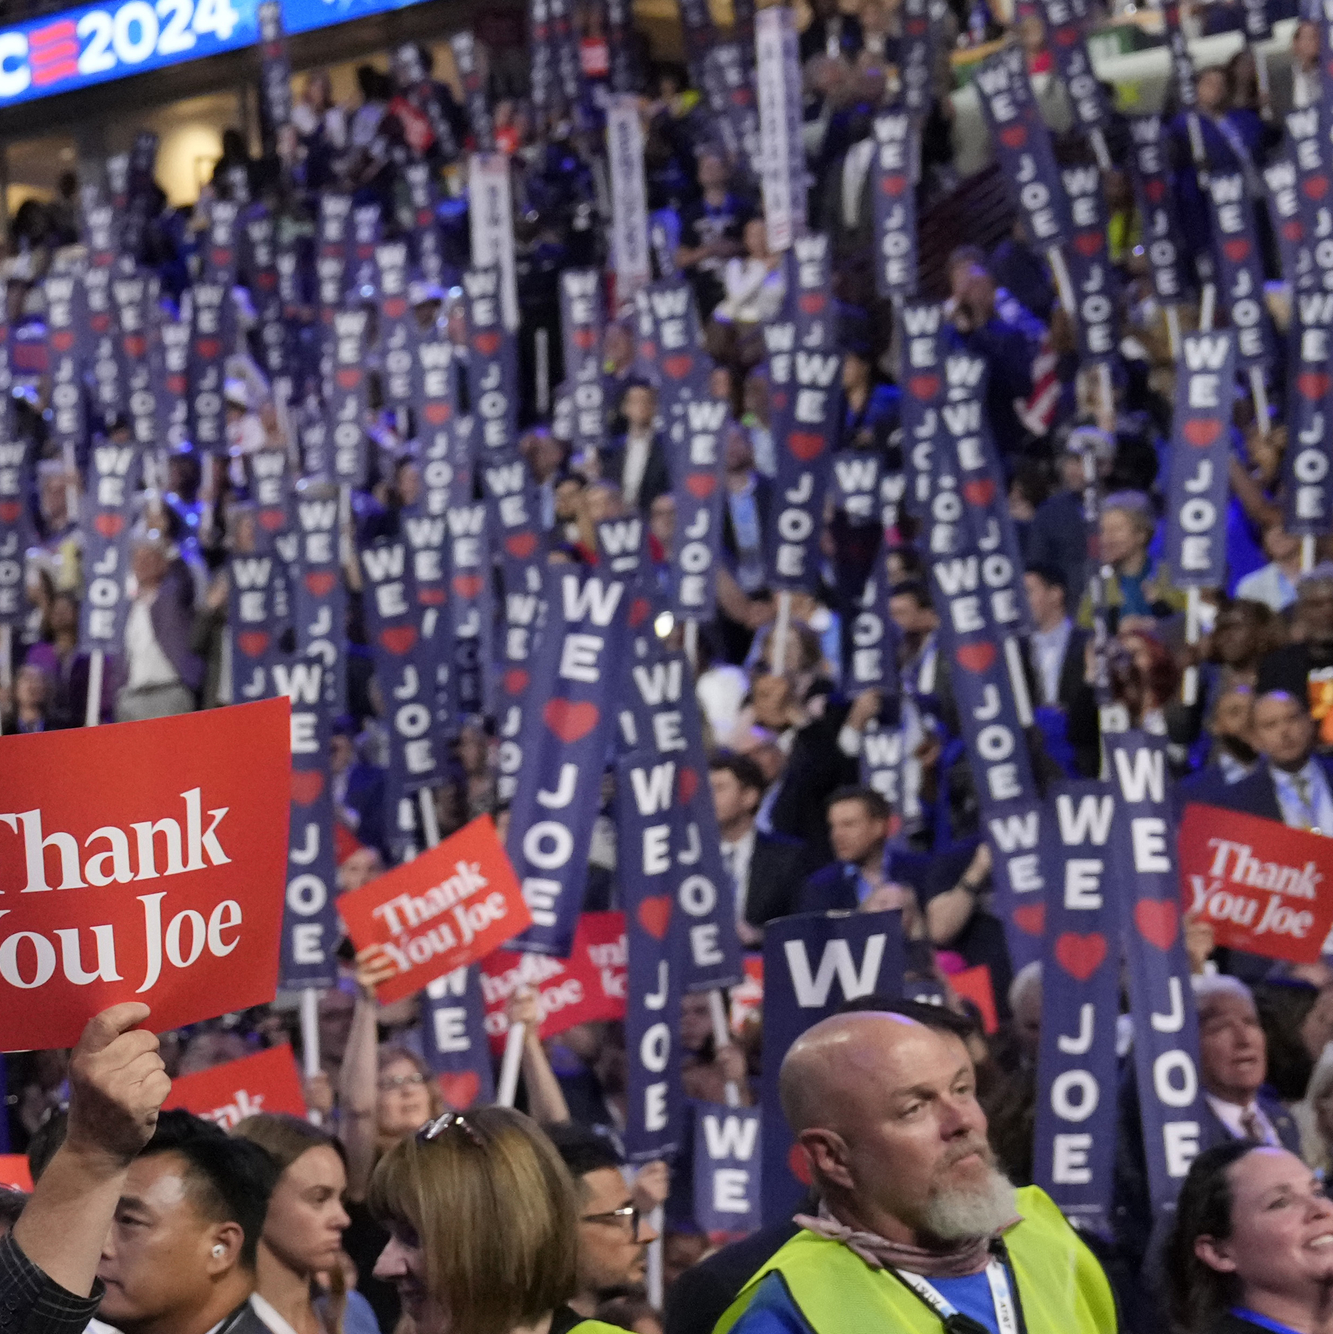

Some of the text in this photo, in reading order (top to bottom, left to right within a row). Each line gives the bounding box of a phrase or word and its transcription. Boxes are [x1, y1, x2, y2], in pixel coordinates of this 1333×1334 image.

[76, 0, 237, 73] 2024
[978, 68, 1018, 123] WE
[1285, 108, 1322, 170] WE
[874, 115, 910, 288] WE JOE
[1264, 162, 1298, 217] WE
[563, 271, 598, 323] WE
[1062, 167, 1114, 354] WE JOE
[1210, 175, 1265, 358] WE JOE
[333, 311, 368, 362] WE
[463, 271, 509, 446] WE JOE
[650, 287, 688, 349] WE
[903, 305, 940, 367] WE
[420, 341, 450, 396] WE
[253, 453, 285, 502] WE
[777, 352, 839, 577] WE JOE
[1181, 336, 1229, 570] WE JOE
[1294, 412, 1331, 519] JOE
[89, 447, 133, 640] WE JOE
[299, 501, 336, 563] WE
[449, 506, 486, 567] WE
[679, 400, 726, 606] WE JOE
[234, 557, 273, 622] WE
[559, 575, 624, 683] WE
[363, 544, 436, 776] WE JOE
[934, 558, 1022, 800] WE JOE
[271, 663, 328, 965] WE JOE
[522, 763, 579, 927] JOE
[634, 660, 724, 967] WE JOE
[990, 812, 1045, 893] WE
[373, 860, 489, 938] Thank
[1190, 874, 1316, 939] You Joe
[1208, 838, 1323, 901] Thank
[135, 892, 243, 995] Joe
[381, 893, 508, 972] You Joe
[632, 761, 676, 1132] WE JOE
[784, 933, 887, 1008] W
[1115, 747, 1200, 1177] WE JOE
[1051, 795, 1113, 1184] WE JOE
[703, 1116, 761, 1213] WE
